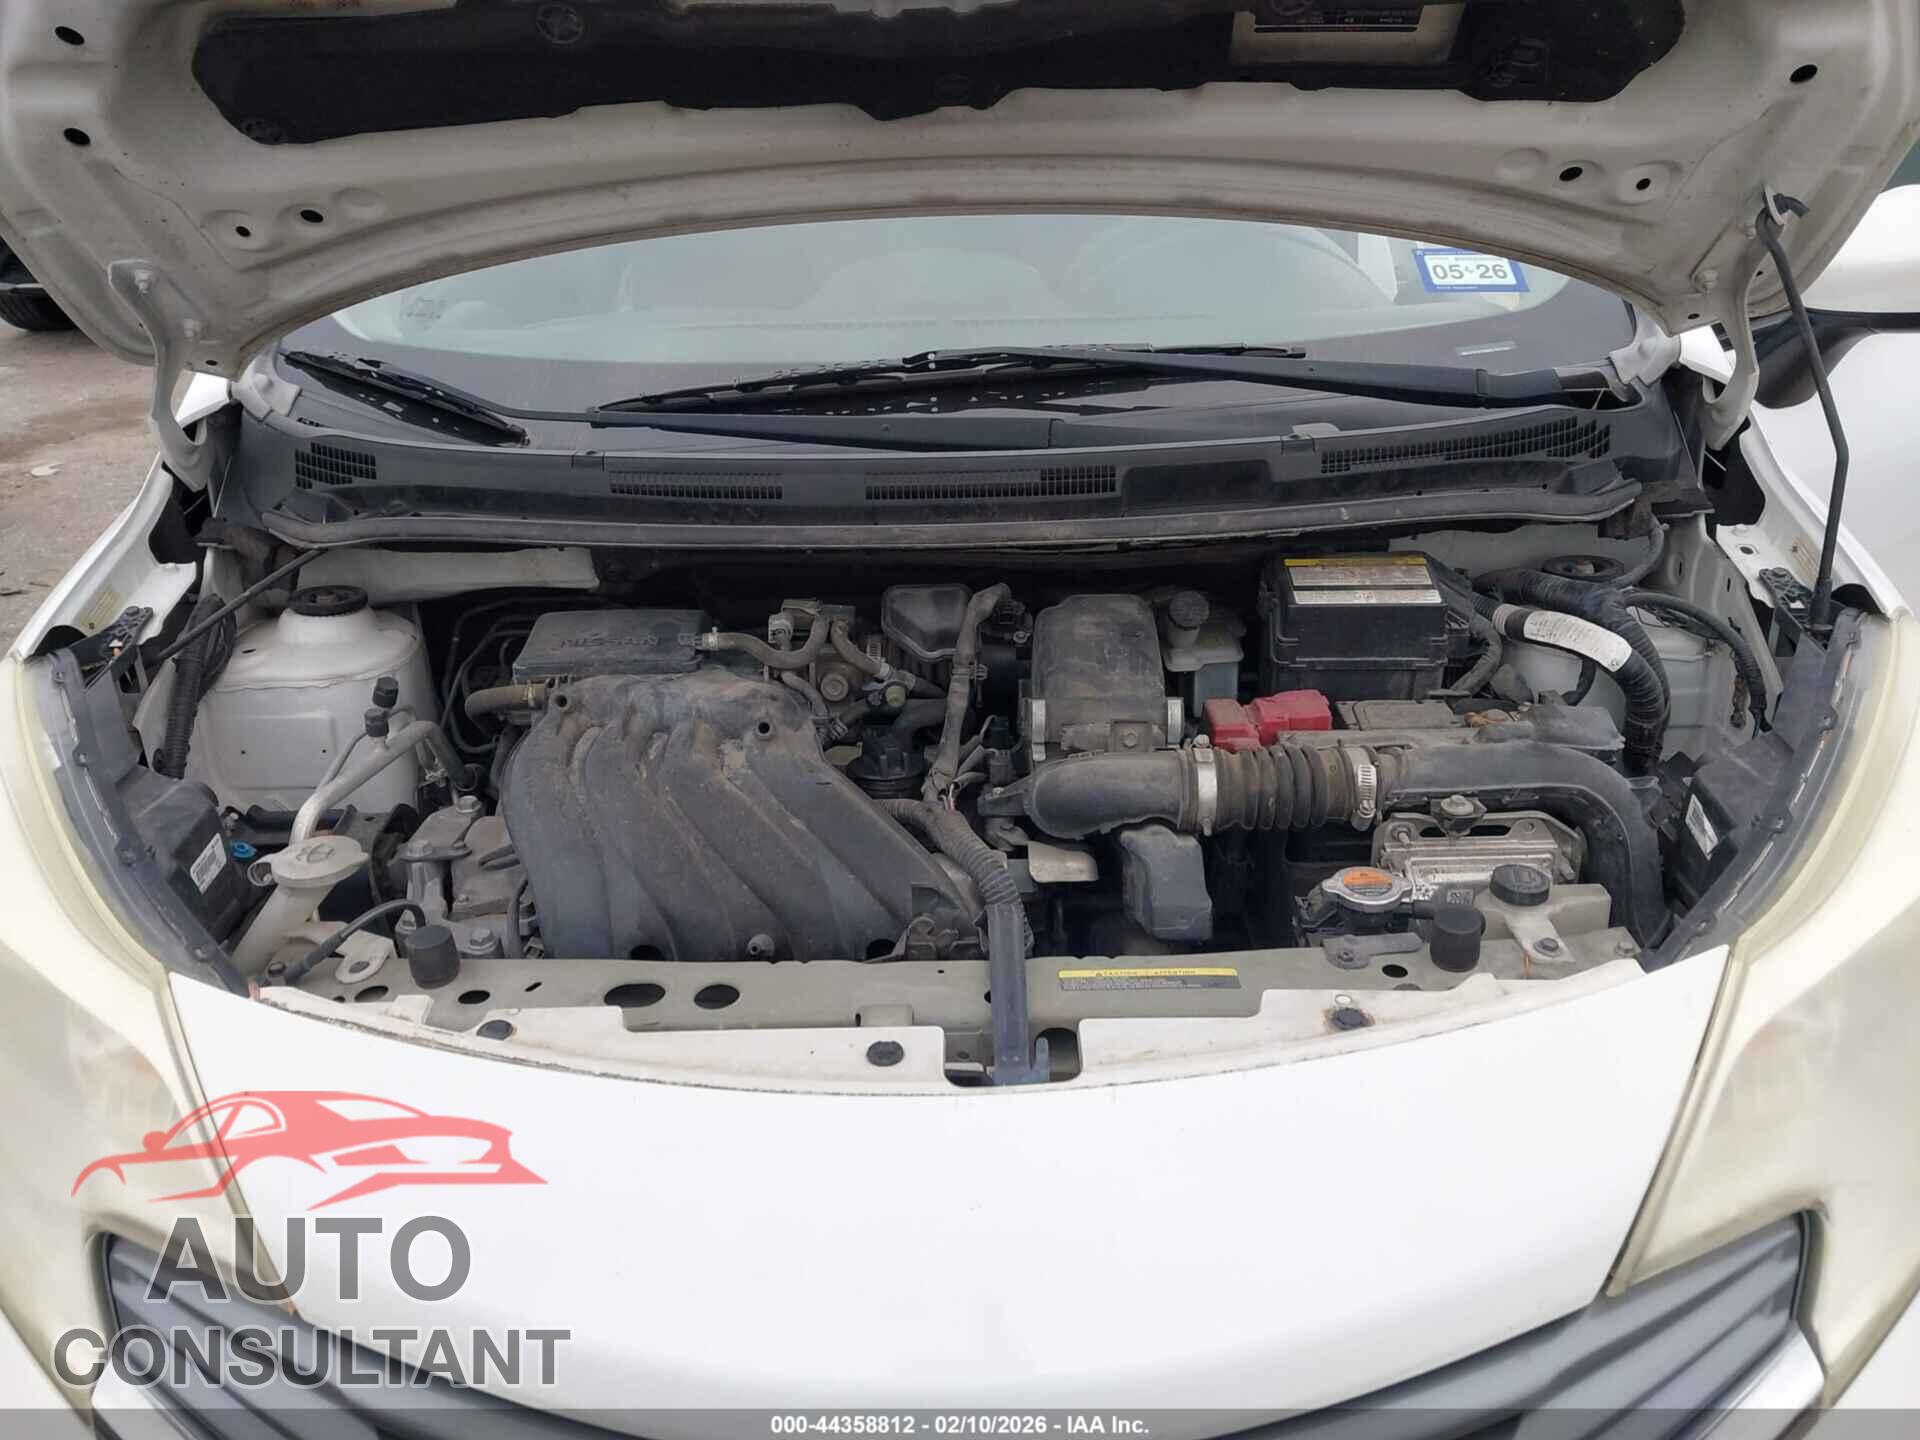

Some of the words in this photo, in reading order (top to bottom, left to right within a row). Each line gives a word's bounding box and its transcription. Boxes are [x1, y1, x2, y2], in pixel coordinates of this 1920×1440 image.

[1432, 264, 1464, 280] 05
[1475, 263, 1508, 280] 26
[560, 636, 662, 648] NISSAN
